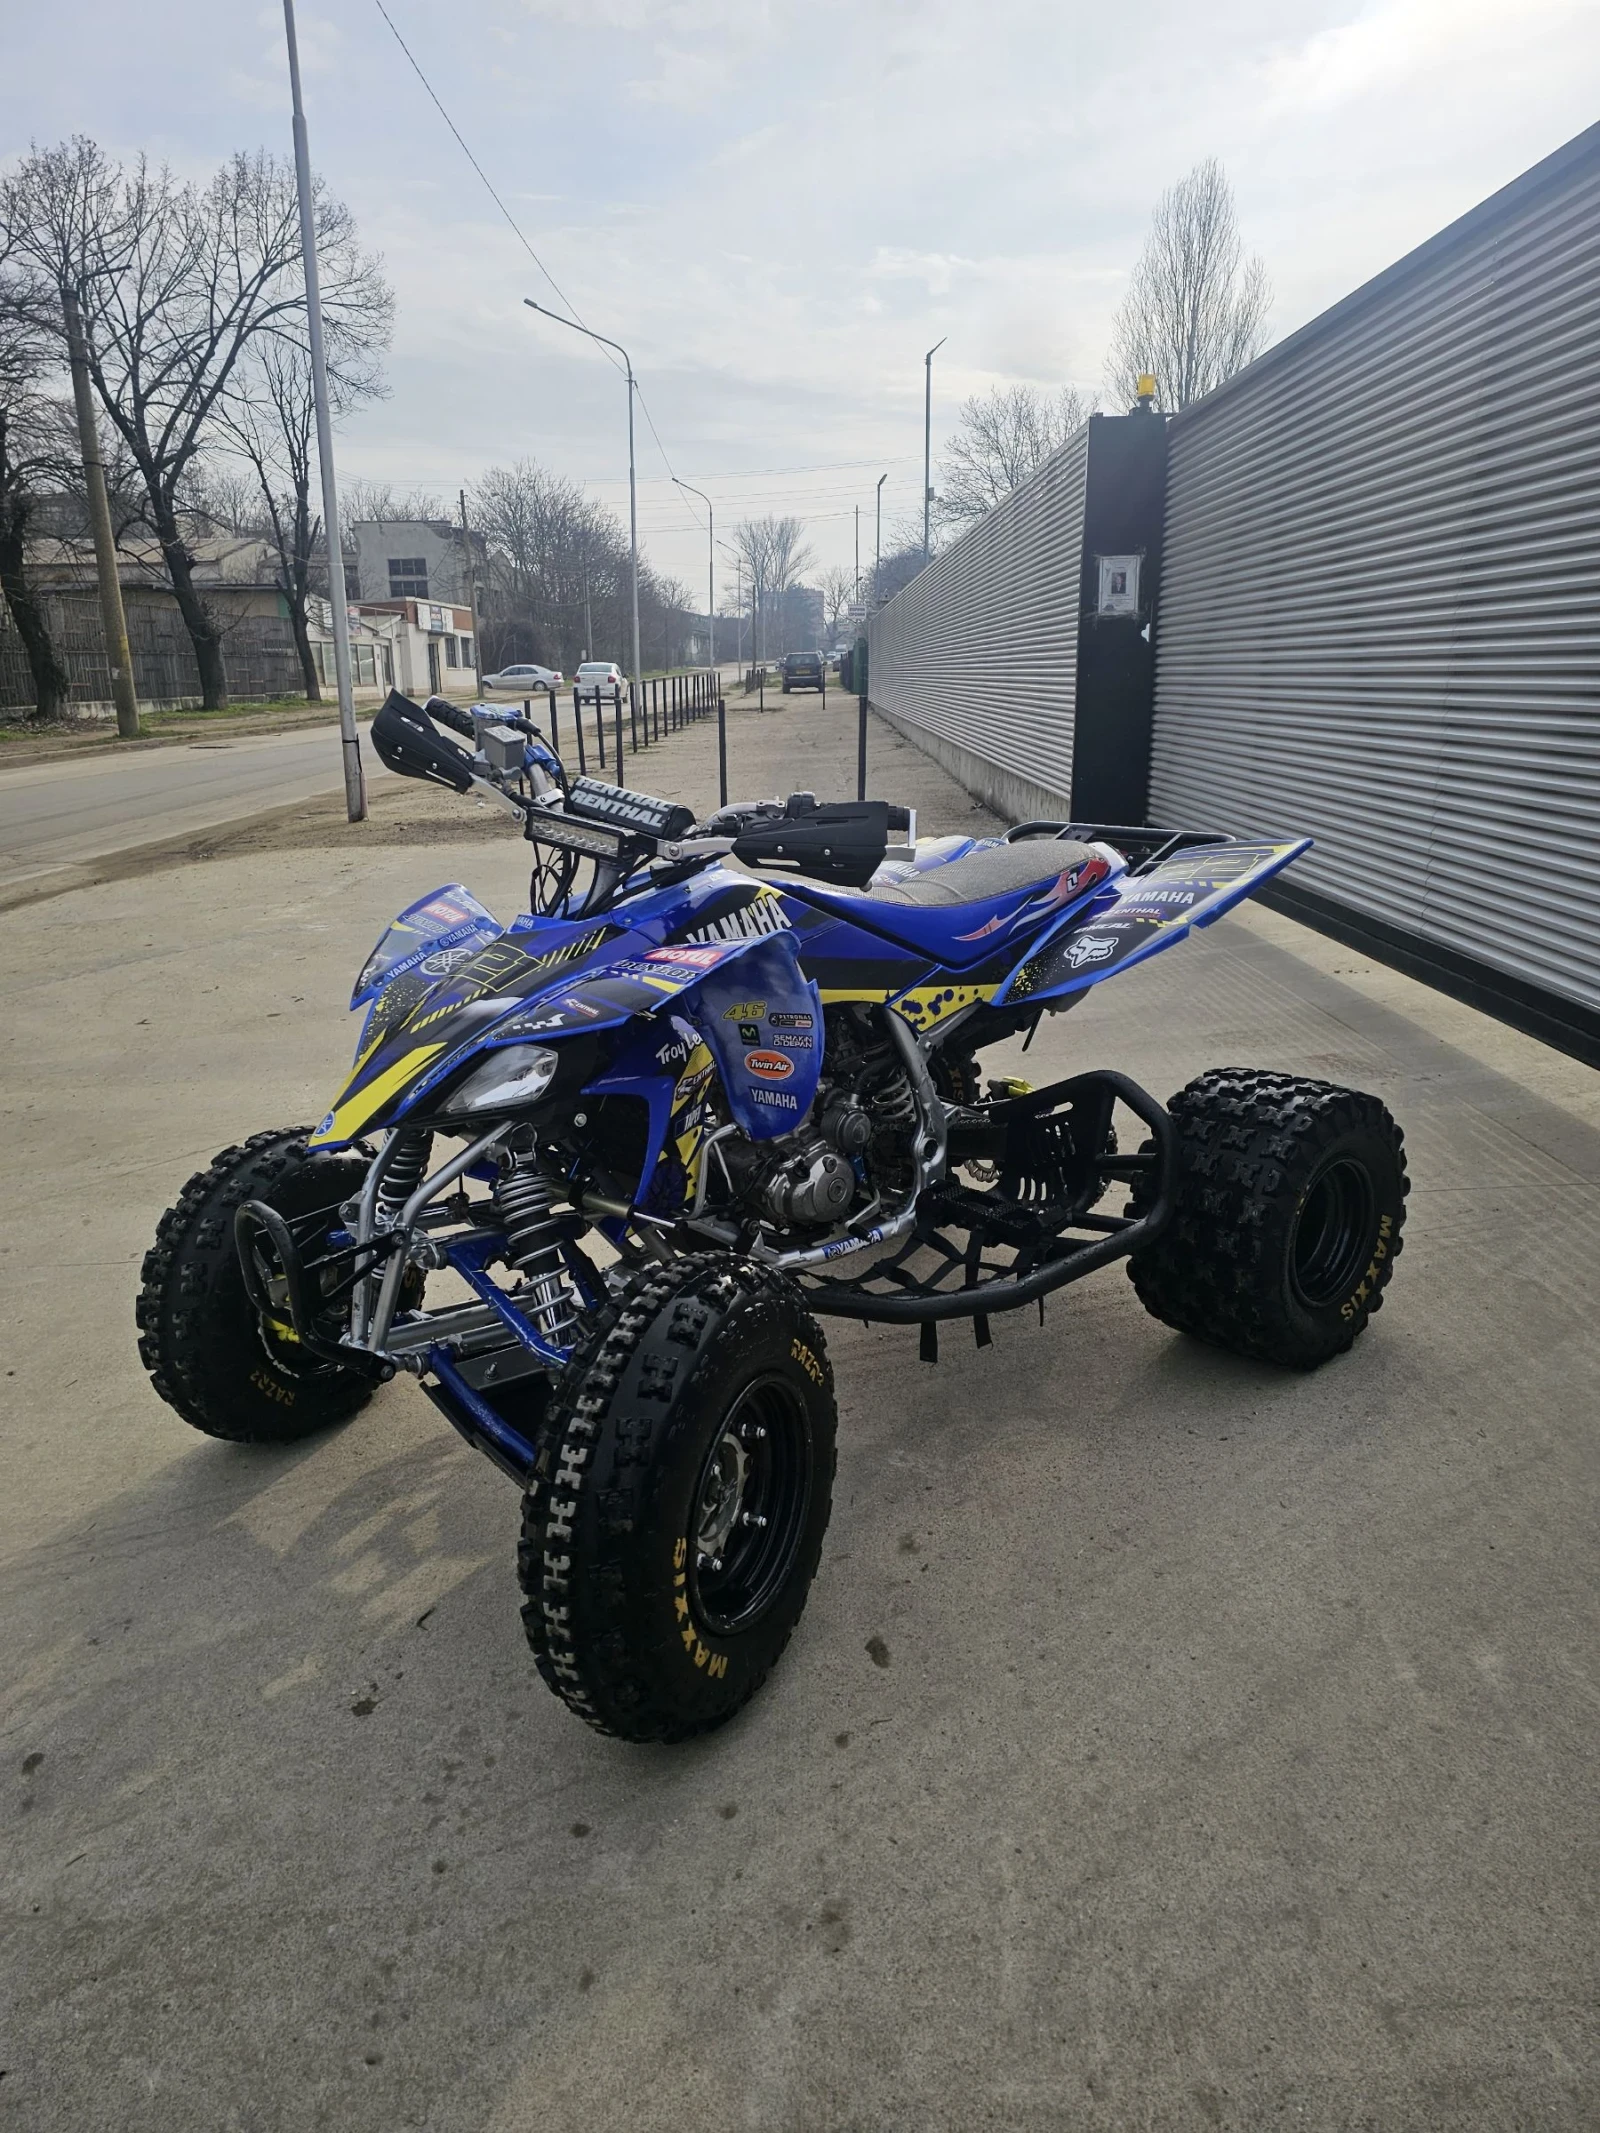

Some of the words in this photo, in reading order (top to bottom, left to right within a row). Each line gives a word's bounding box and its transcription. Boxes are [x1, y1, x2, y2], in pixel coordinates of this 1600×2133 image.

[575, 776, 673, 813] RENTHAL
[570, 789, 665, 828] RENTHAL
[1122, 890, 1195, 905] YAMAHA
[447, 923, 479, 944] YAMAHA
[386, 951, 428, 979] YAMAHA
[651, 949, 716, 966] MOTUL
[723, 1001, 767, 1021] 46
[656, 1043, 687, 1065] Troy
[750, 1058, 773, 1070] Twin
[773, 1060, 790, 1071] Air
[751, 1088, 798, 1110] YAMAHA
[1341, 1214, 1394, 1322] MAXXIS
[672, 1537, 729, 1680] MAXXIS
